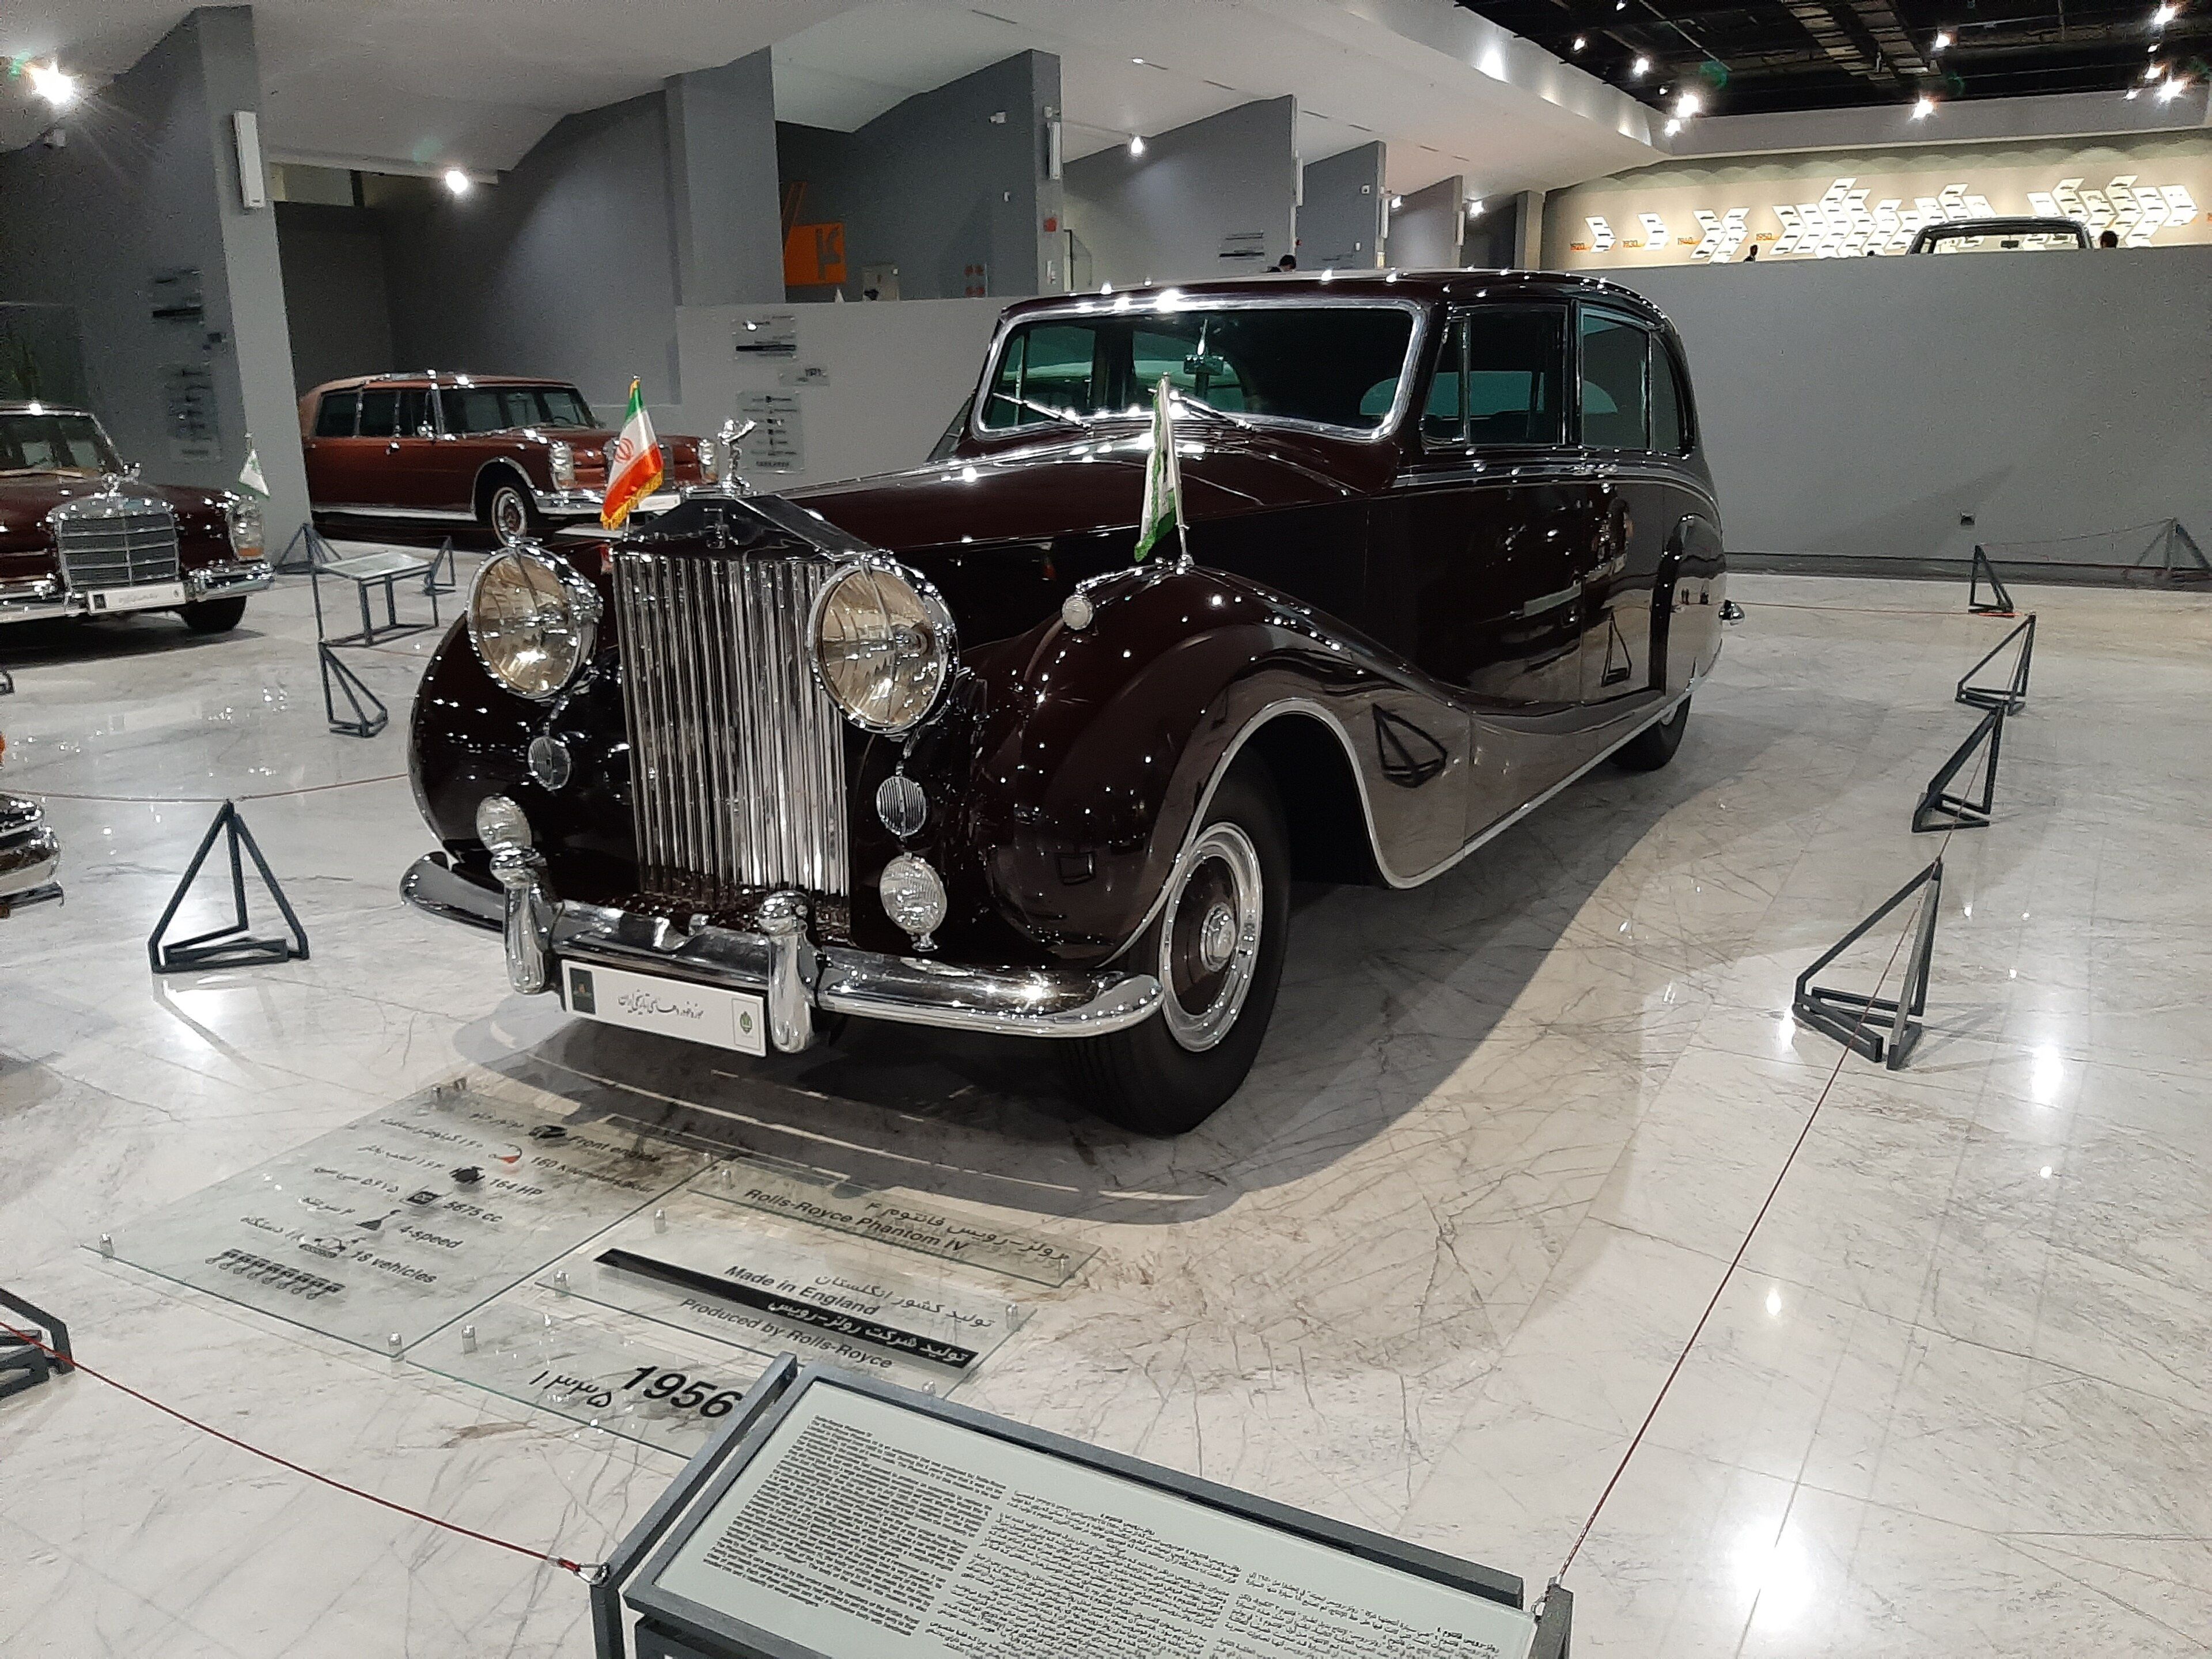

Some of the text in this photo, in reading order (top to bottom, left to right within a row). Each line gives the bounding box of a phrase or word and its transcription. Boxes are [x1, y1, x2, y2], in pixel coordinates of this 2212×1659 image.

[531, 1156, 559, 1168] 160
[489, 1179, 544, 1196] 164 HP
[442, 1200, 484, 1217] 5675
[745, 1187, 969, 1252] Rolls-Royce Phantom IV
[881, 1207, 945, 1227] فانتوم
[399, 1225, 464, 1249] 4-speed
[948, 1223, 1070, 1261] رولز-رویس
[370, 1257, 438, 1283] vehicles
[723, 1265, 881, 1316] Made in England
[815, 1274, 997, 1328] تولید کشور انگلستان
[679, 1297, 894, 1370] Produced by Rolls-Royce
[767, 1300, 969, 1363] تولید شرکت رولز-رویس
[529, 1370, 612, 1408] ۱۳۳۵
[622, 1365, 744, 1418] 1956
